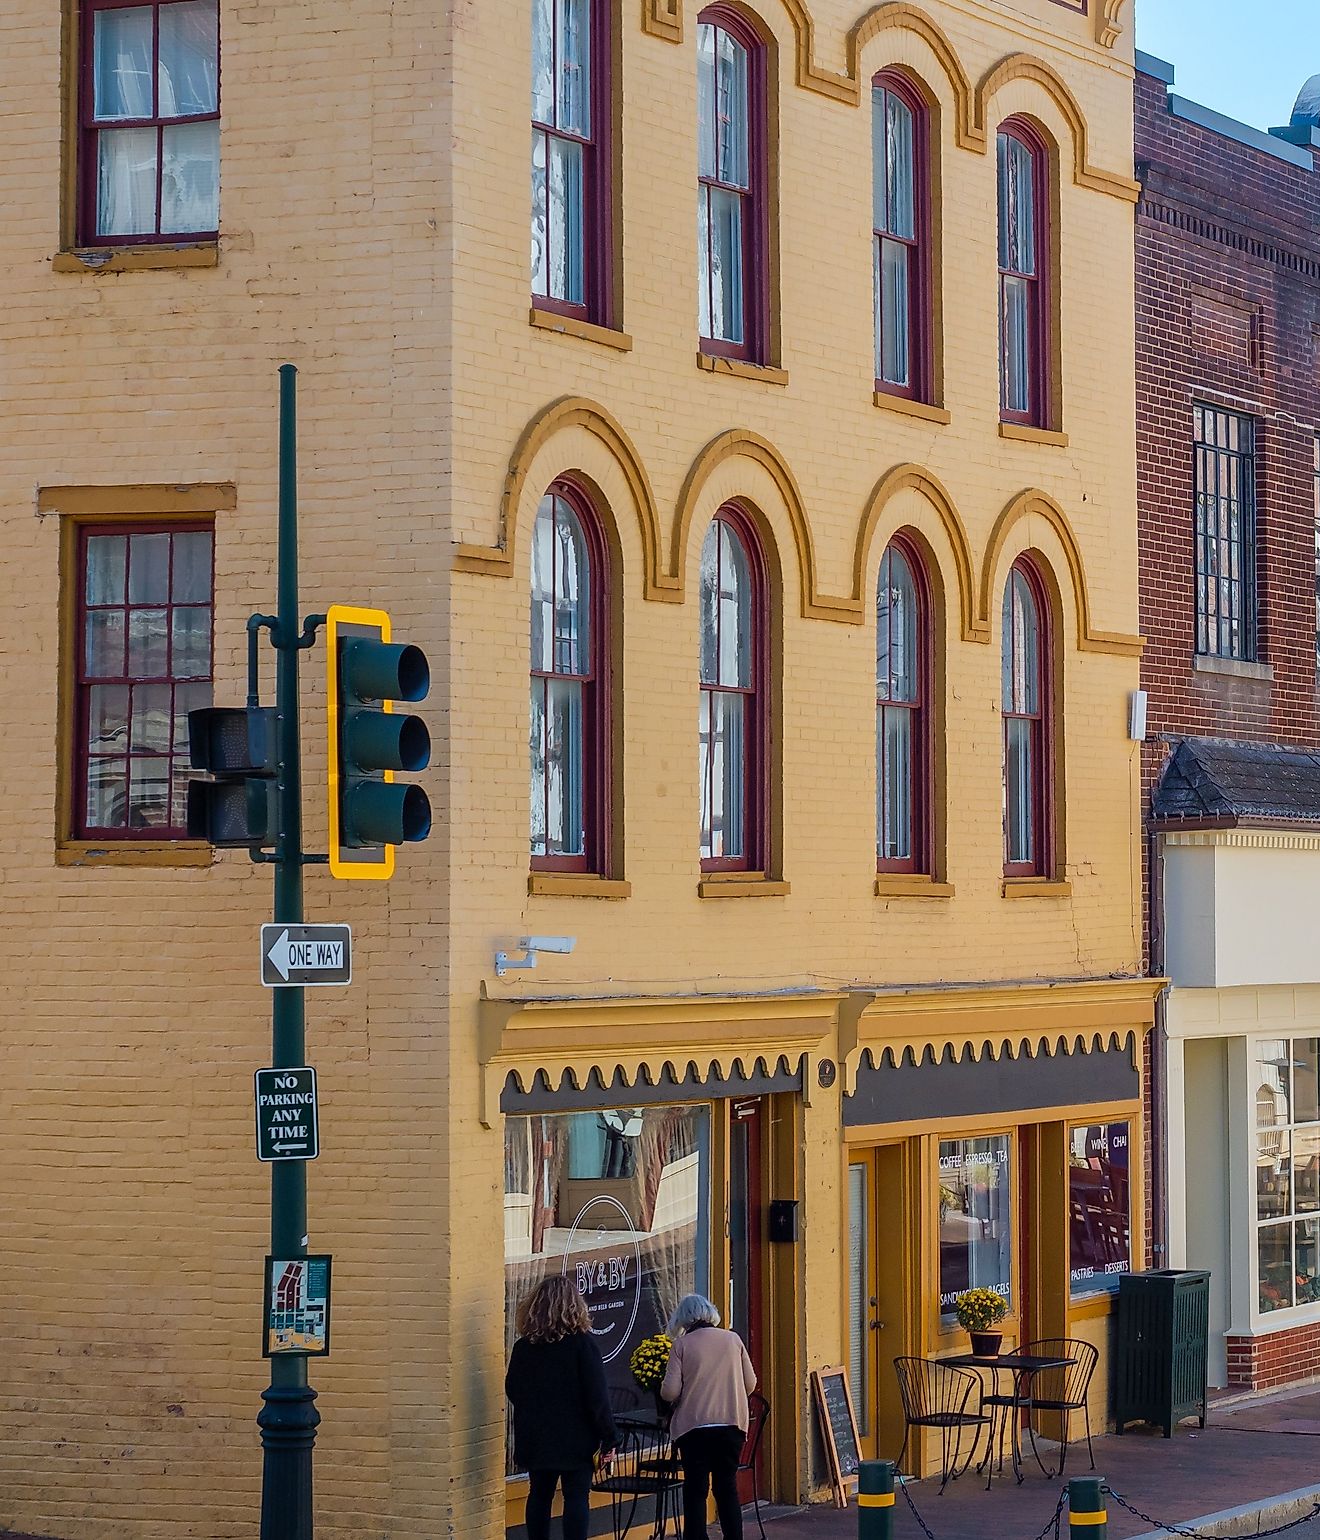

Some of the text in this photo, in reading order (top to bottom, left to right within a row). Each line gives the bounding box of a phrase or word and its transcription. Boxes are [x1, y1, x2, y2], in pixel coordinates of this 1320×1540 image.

[289, 944, 341, 965] ONE WAY
[274, 1076, 298, 1089] NO
[260, 1092, 314, 1106] PARKING
[272, 1109, 302, 1122] ANY
[267, 1125, 309, 1139] TIME
[1113, 1135, 1127, 1148] CHAI
[939, 1150, 1008, 1169] COFFEE ESPRESSO TEA
[576, 1256, 630, 1296] BY & BY
[1071, 1260, 1128, 1281] PASTRIES DESSERTS
